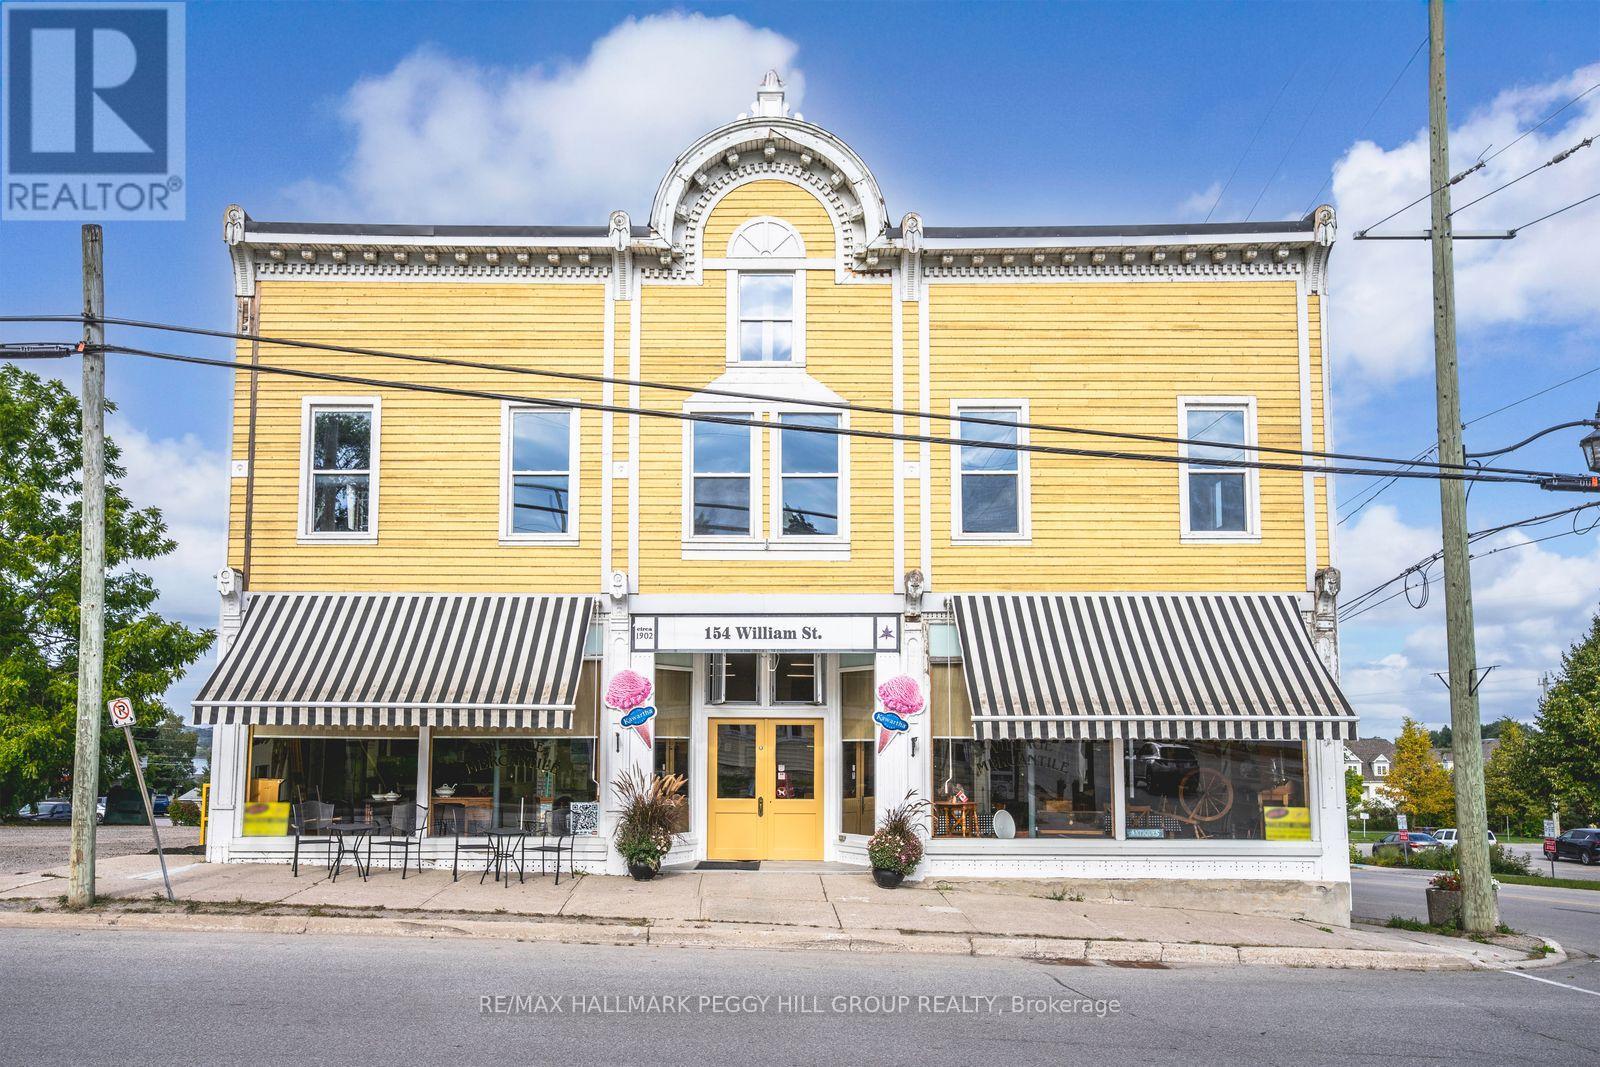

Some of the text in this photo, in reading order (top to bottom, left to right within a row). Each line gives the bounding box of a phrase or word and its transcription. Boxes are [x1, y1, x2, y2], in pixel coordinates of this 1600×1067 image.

[636, 632, 654, 640] 1902
[704, 626, 823, 640] 154 William St.
[623, 708, 654, 725] Kawartha
[876, 713, 907, 729] Kawartha
[464, 754, 561, 775] MERCTILE
